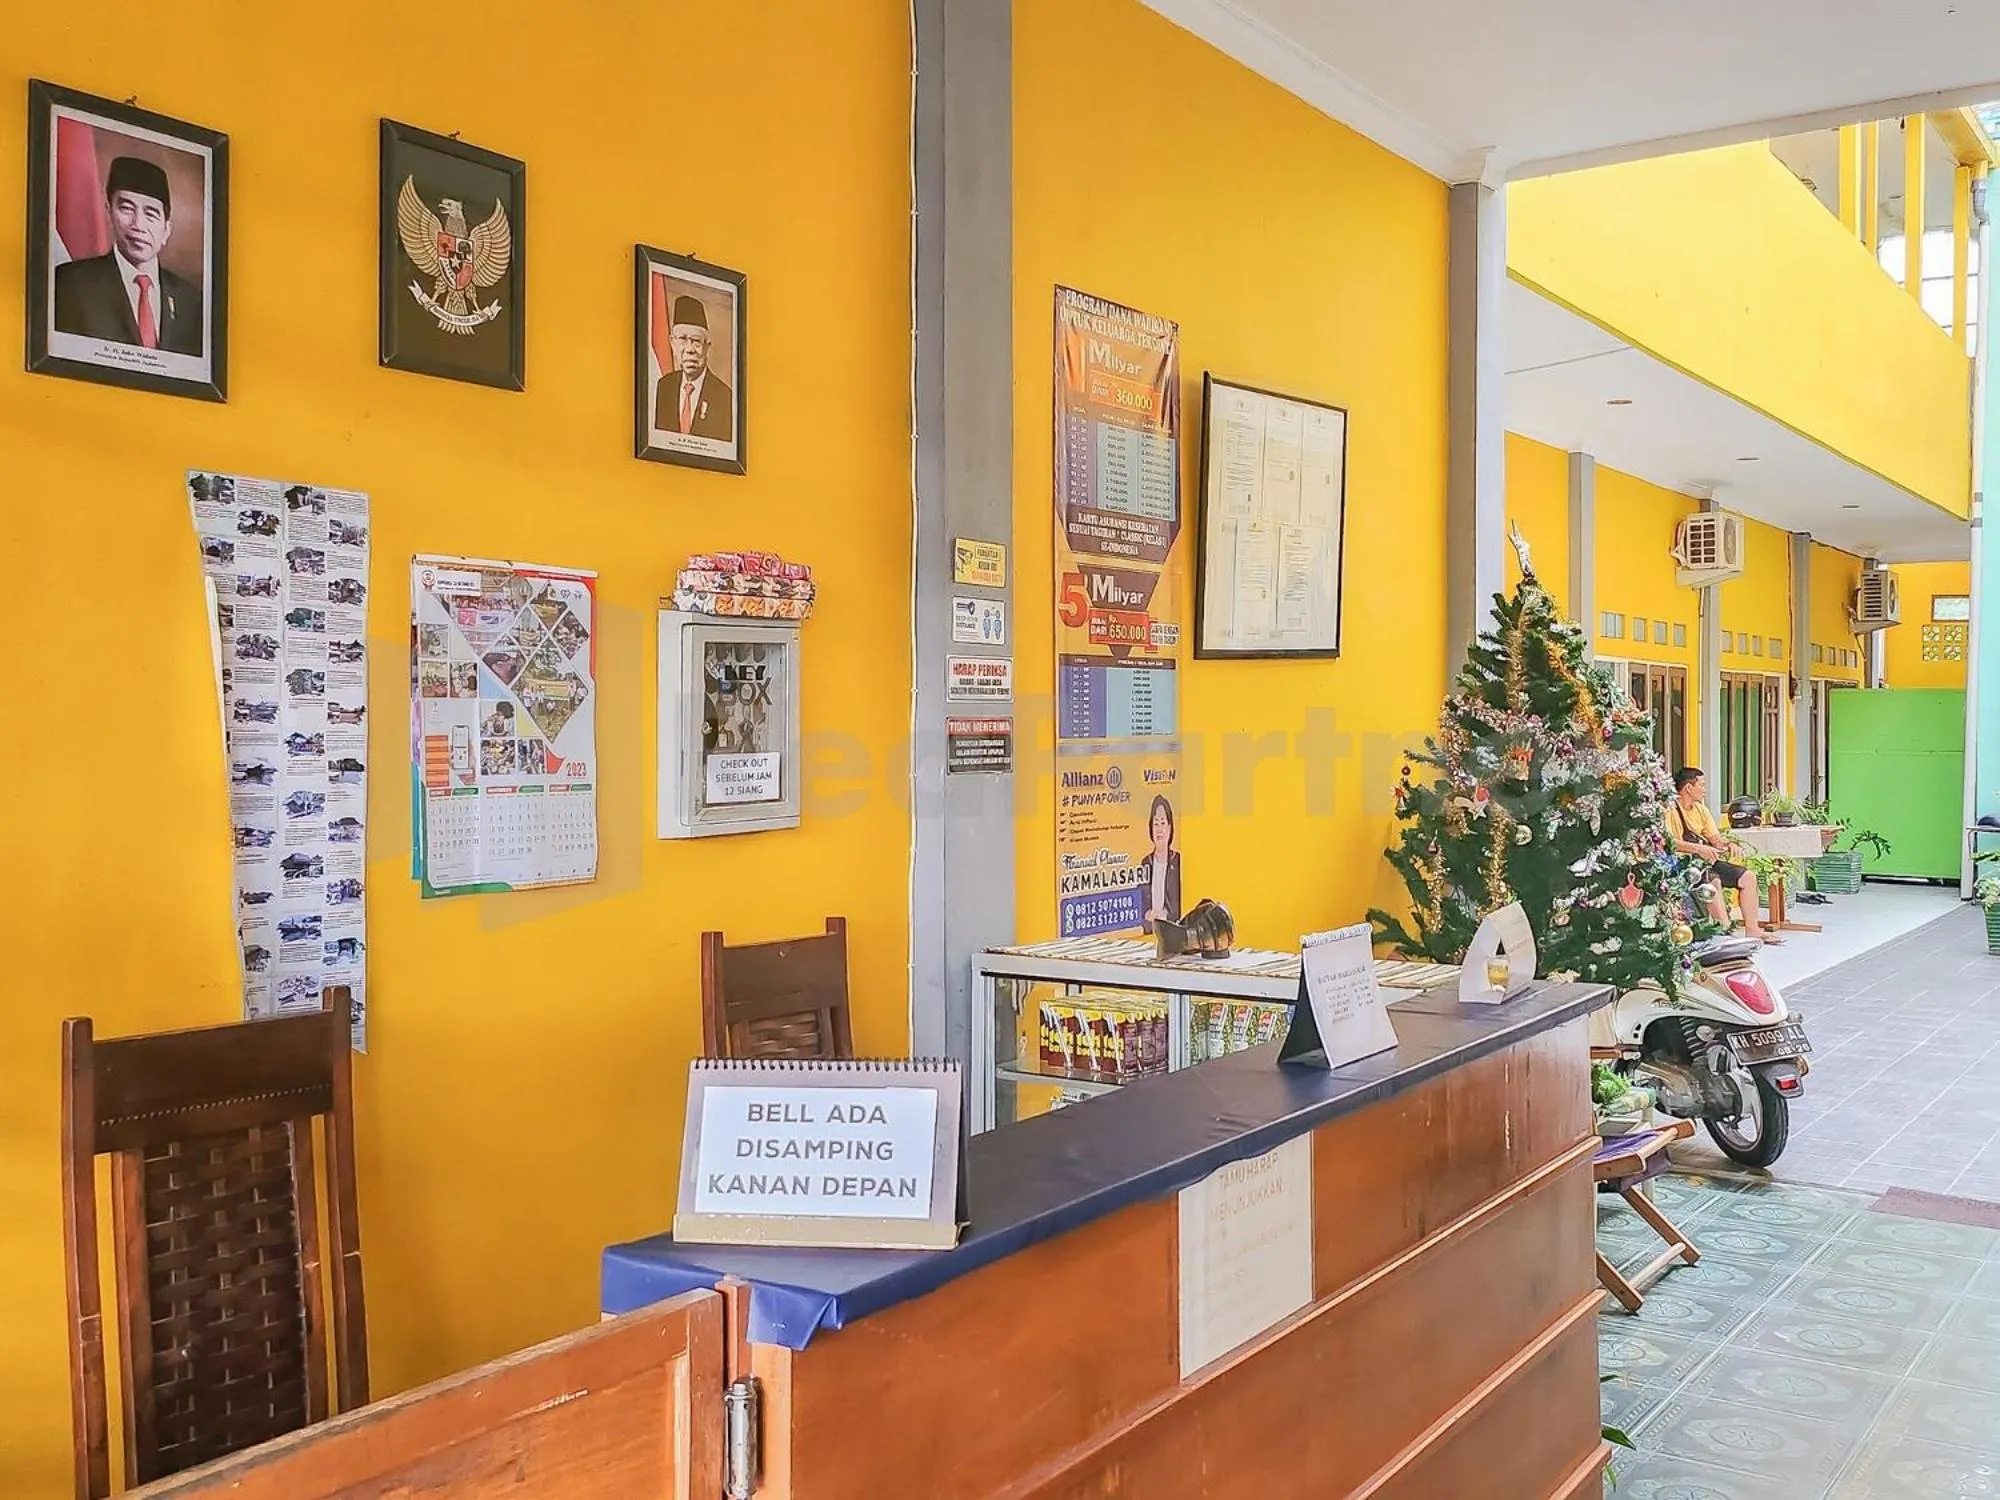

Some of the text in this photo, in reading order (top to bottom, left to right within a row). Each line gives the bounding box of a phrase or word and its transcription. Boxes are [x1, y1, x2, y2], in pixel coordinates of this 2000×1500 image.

[1066, 289, 1108, 318] PROGRAM
[1109, 304, 1132, 326] DANA
[1087, 338, 1142, 376] Milyar
[1059, 571, 1144, 628] 5 Milyar
[1090, 624, 1108, 636] DARI
[1109, 624, 1147, 641] 650.000
[724, 664, 767, 681] KEY
[952, 663, 1007, 678] HARAP PERIKSA
[566, 761, 587, 777] 2023
[720, 757, 769, 769] CHECK OUT
[715, 771, 773, 783] SEBELUM JAM
[1061, 770, 1105, 788] Allianz
[724, 784, 764, 797] 12 SIANG
[1061, 867, 1149, 894] KAMALASARI
[1731, 1026, 1806, 1050] KH 5099 AL
[746, 1102, 888, 1124] BELL ADA
[735, 1138, 894, 1161] DISAMPING
[1246, 1152, 1279, 1175] HARAP
[707, 1173, 918, 1199] KANAN DEPAN
